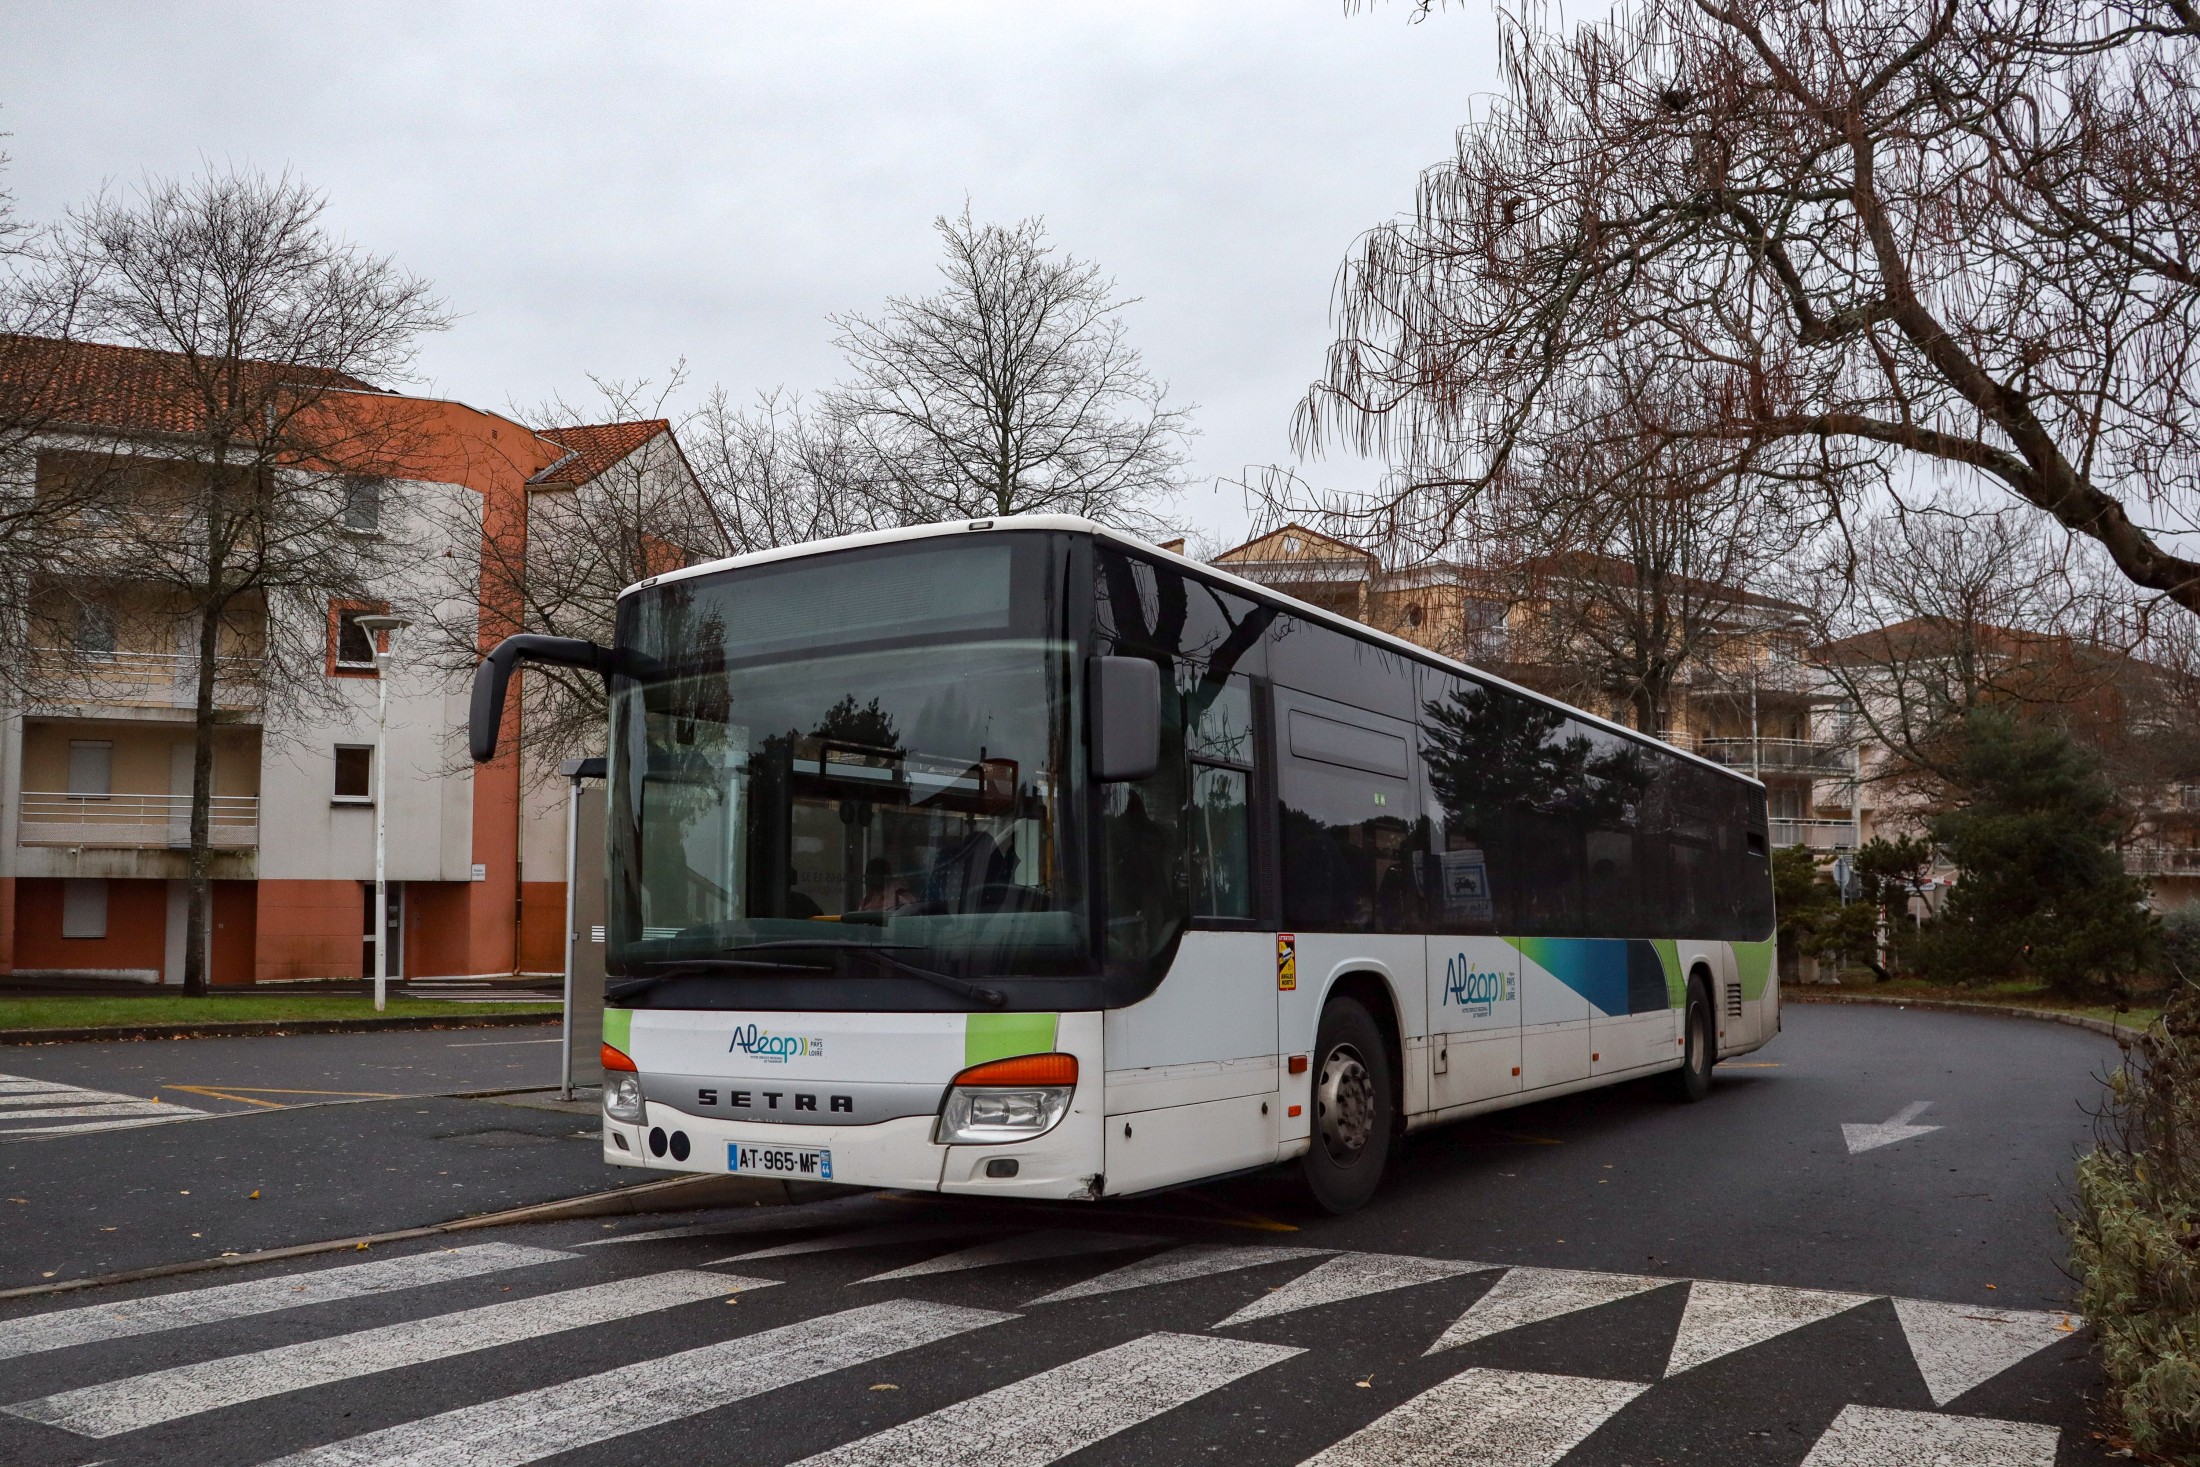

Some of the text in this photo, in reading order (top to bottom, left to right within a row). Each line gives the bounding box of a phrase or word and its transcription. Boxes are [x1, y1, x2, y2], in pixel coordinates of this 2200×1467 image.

[1443, 952, 1498, 1017] Aléop
[728, 1023, 798, 1064] Aléop
[698, 1088, 853, 1113] SETRA
[740, 1148, 820, 1174] AT-965-MF
[822, 1165, 830, 1174] 44
